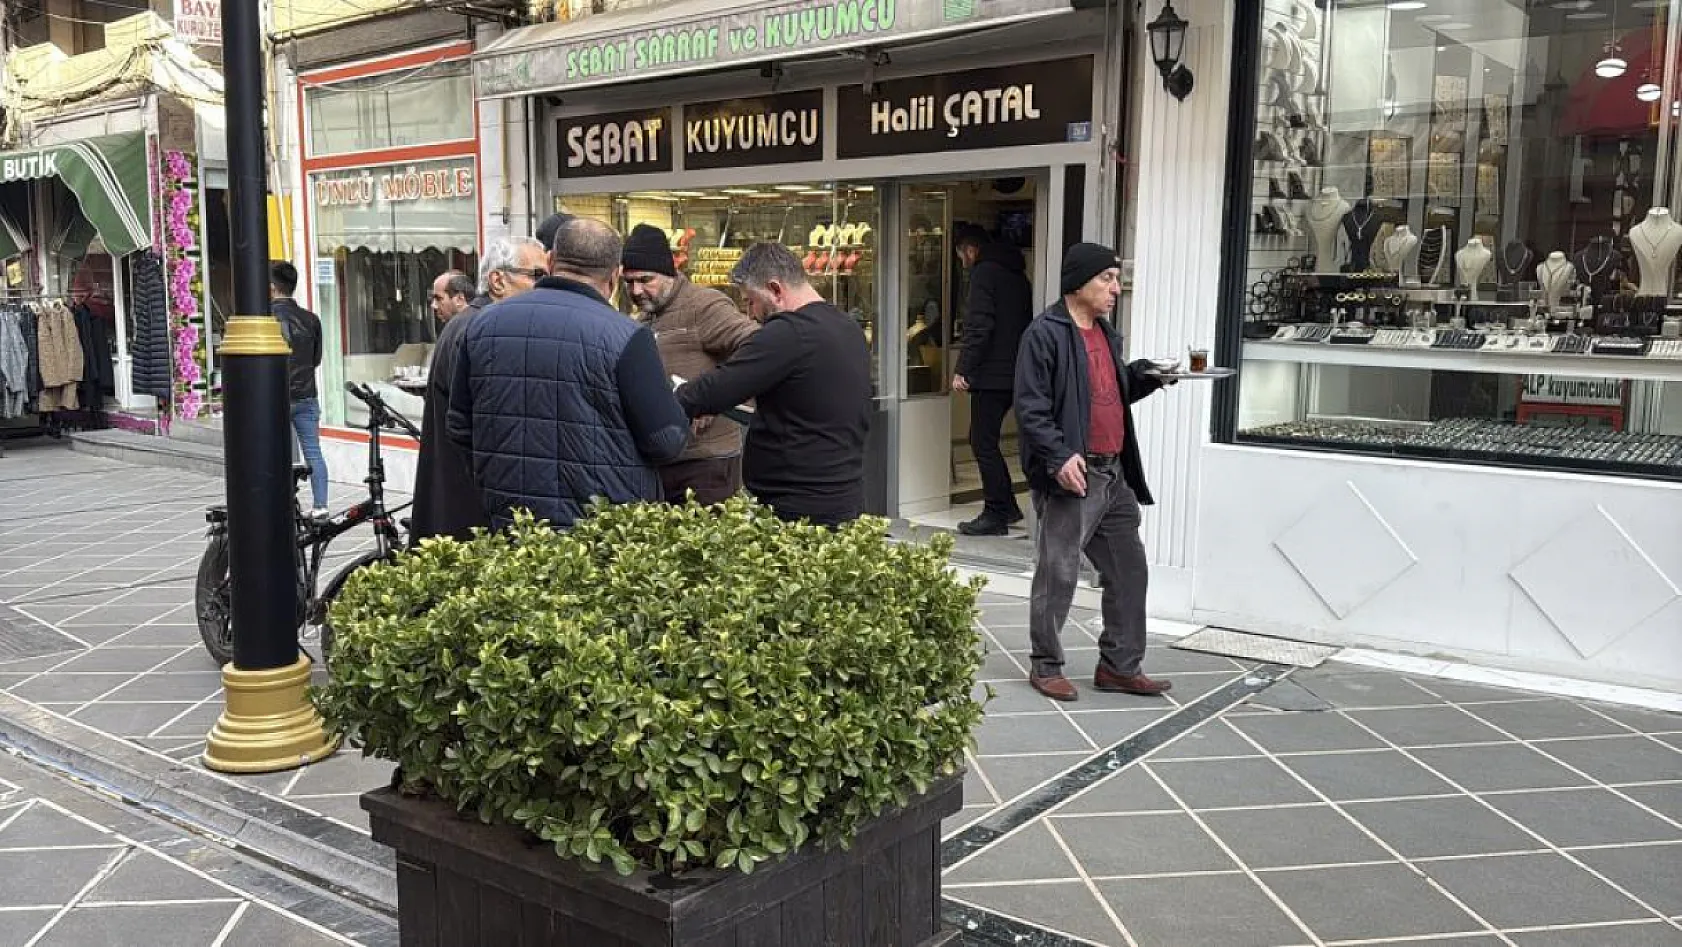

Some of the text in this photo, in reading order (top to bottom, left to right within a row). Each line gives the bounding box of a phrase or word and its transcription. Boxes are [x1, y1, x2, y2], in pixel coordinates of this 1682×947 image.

[566, 0, 896, 80] SEBAT SARRAF ve KUYUMCU
[567, 84, 1041, 168] SEBAT KUYUMCU Halil ÇATAL
[4, 150, 60, 179] BUTİK
[316, 166, 472, 207] ÜNLÜ MÖBLE
